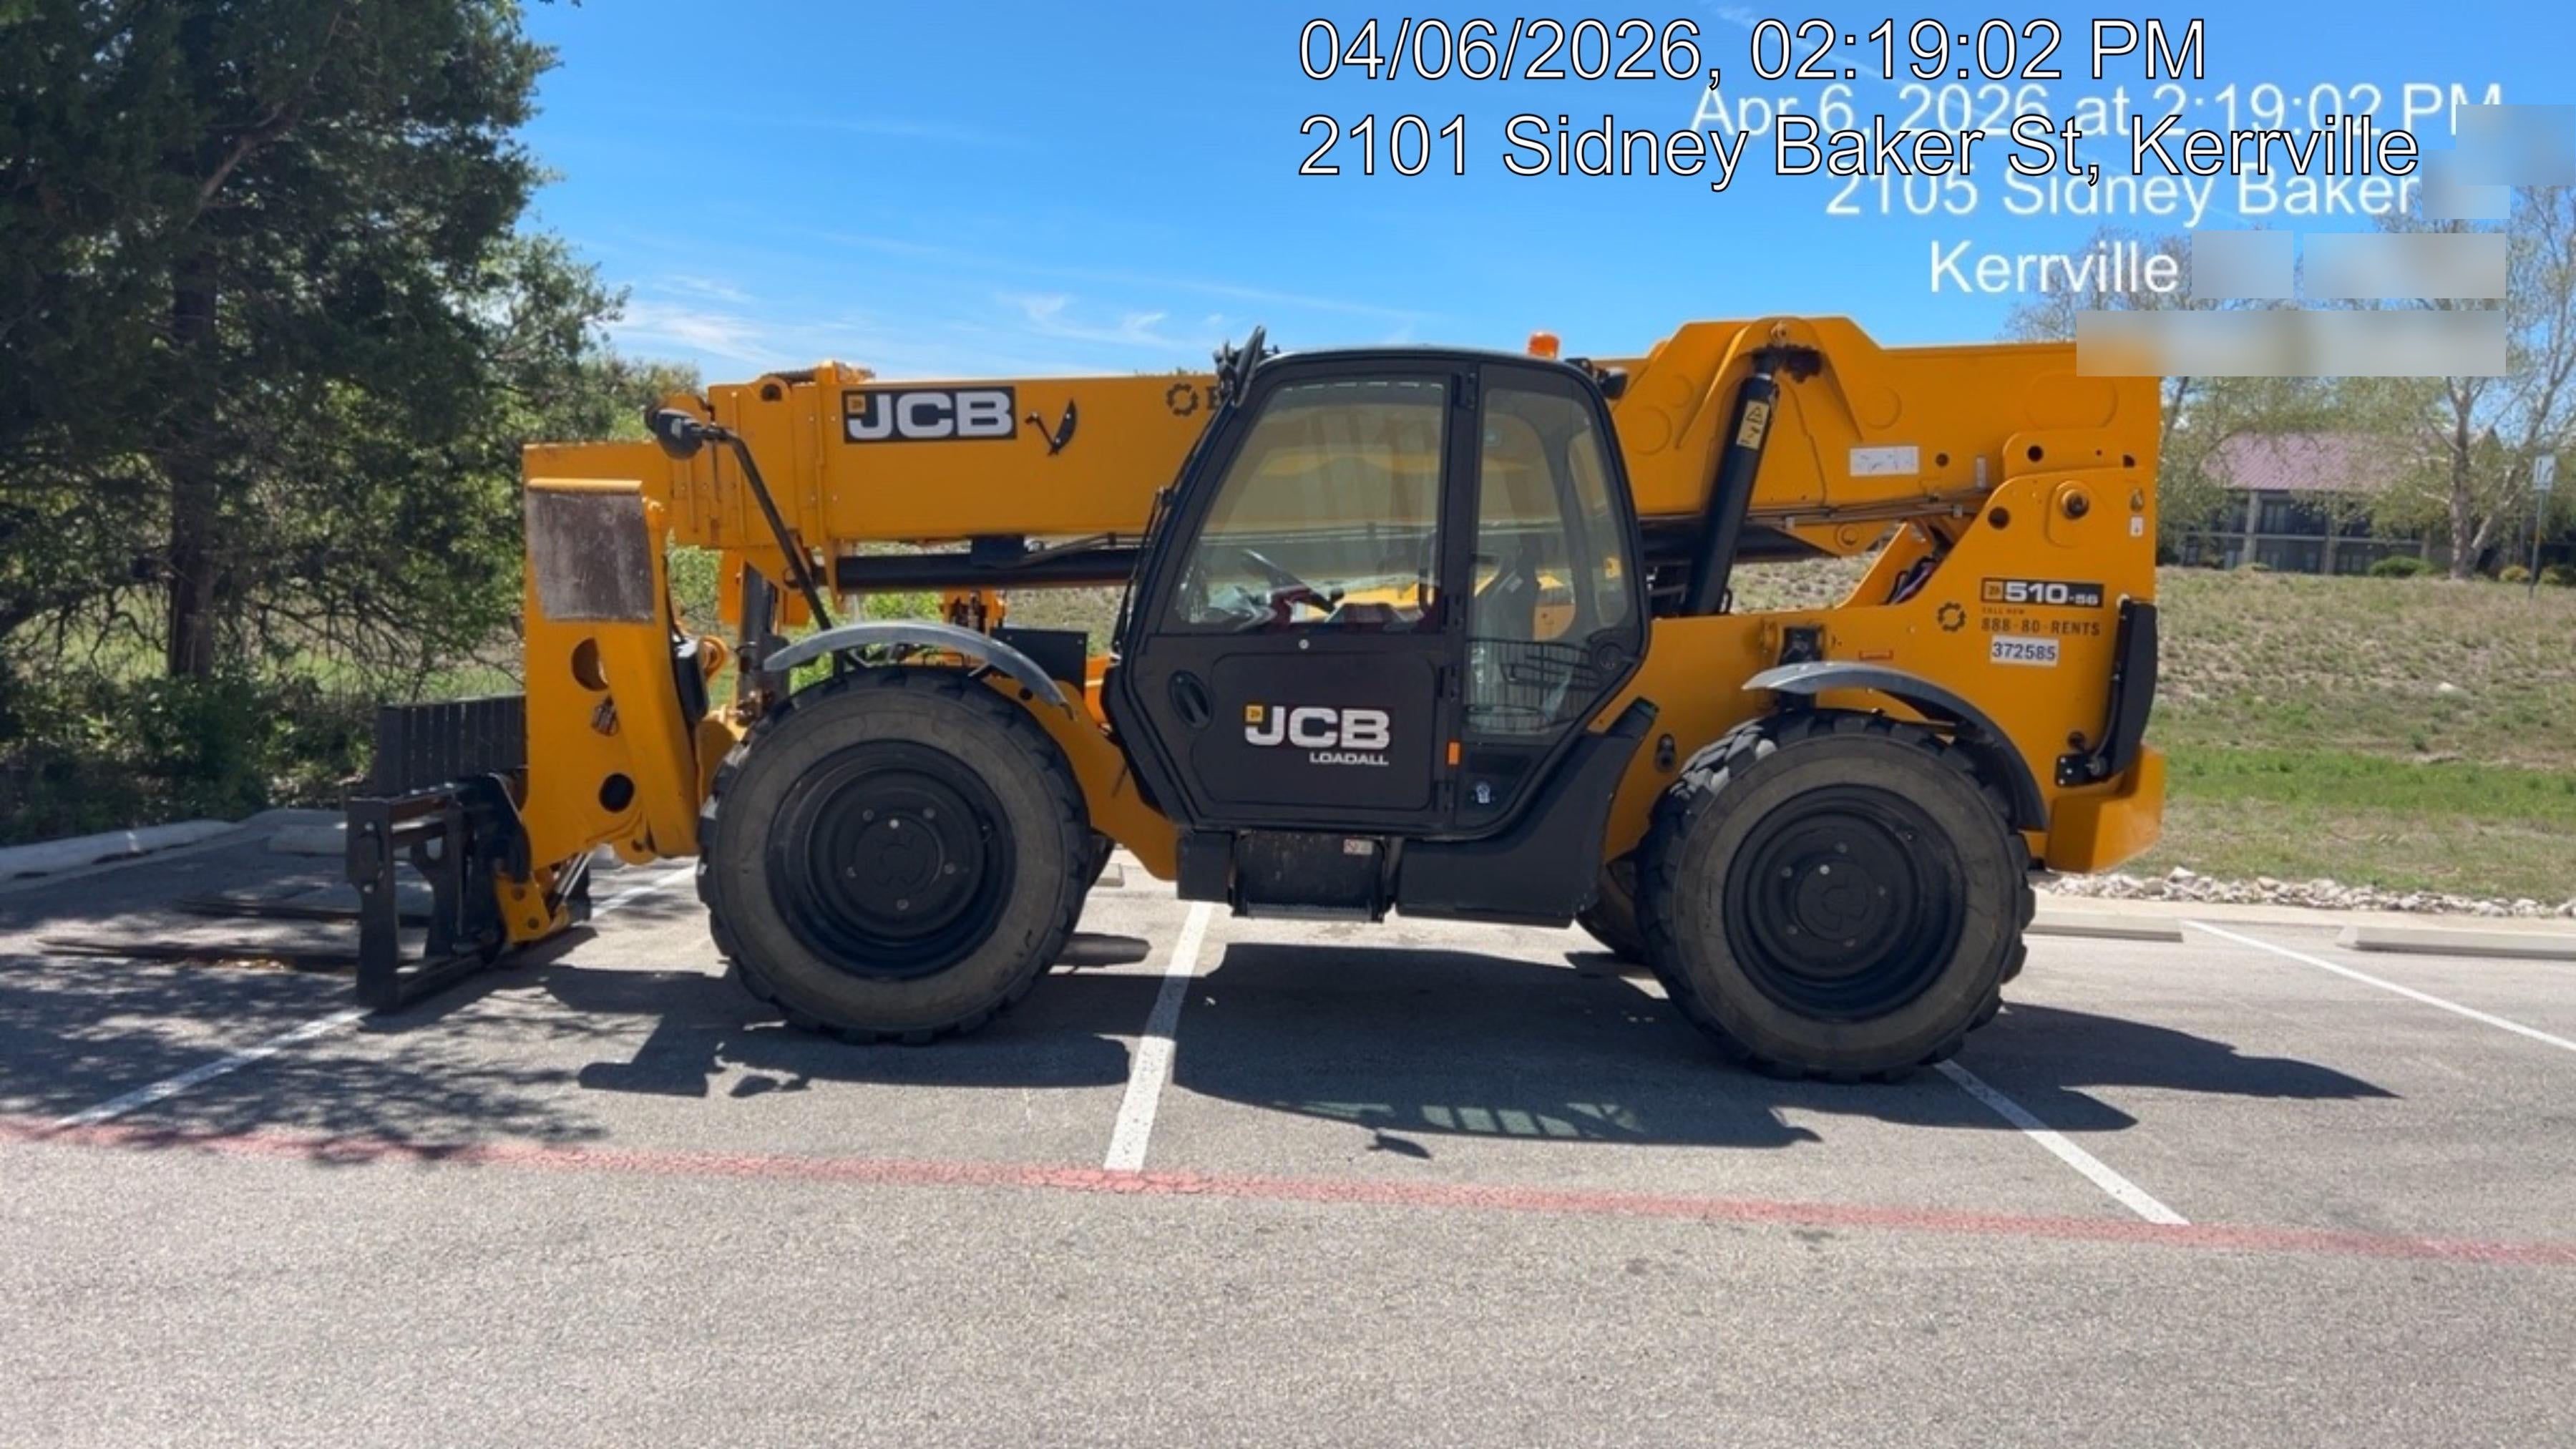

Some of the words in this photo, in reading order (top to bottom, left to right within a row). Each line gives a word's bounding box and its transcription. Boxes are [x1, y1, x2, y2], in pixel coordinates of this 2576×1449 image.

[847, 391, 1013, 439] JCB
[1992, 641, 2056, 660] 372585
[1244, 706, 1390, 749] JCB
[1309, 751, 1390, 766] LOADALL
